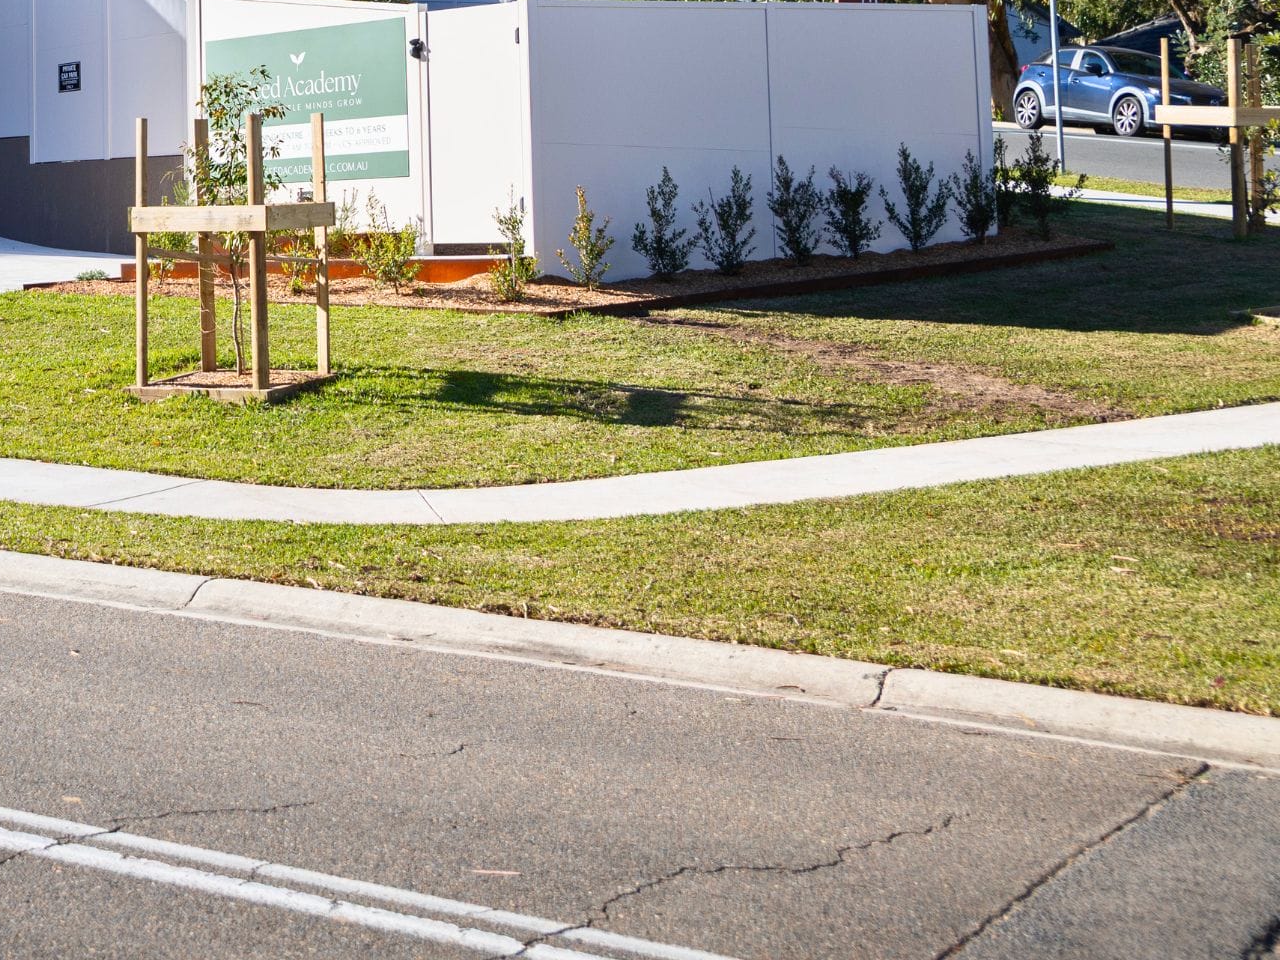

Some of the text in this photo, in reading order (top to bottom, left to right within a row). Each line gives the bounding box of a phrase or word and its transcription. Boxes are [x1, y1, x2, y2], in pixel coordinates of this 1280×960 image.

[284, 70, 362, 97] Academy
[305, 100, 333, 111] MINDS
[336, 97, 363, 107] GROW
[325, 127, 343, 137] EEKS
[345, 126, 354, 136] TO
[362, 124, 387, 134] YEARS
